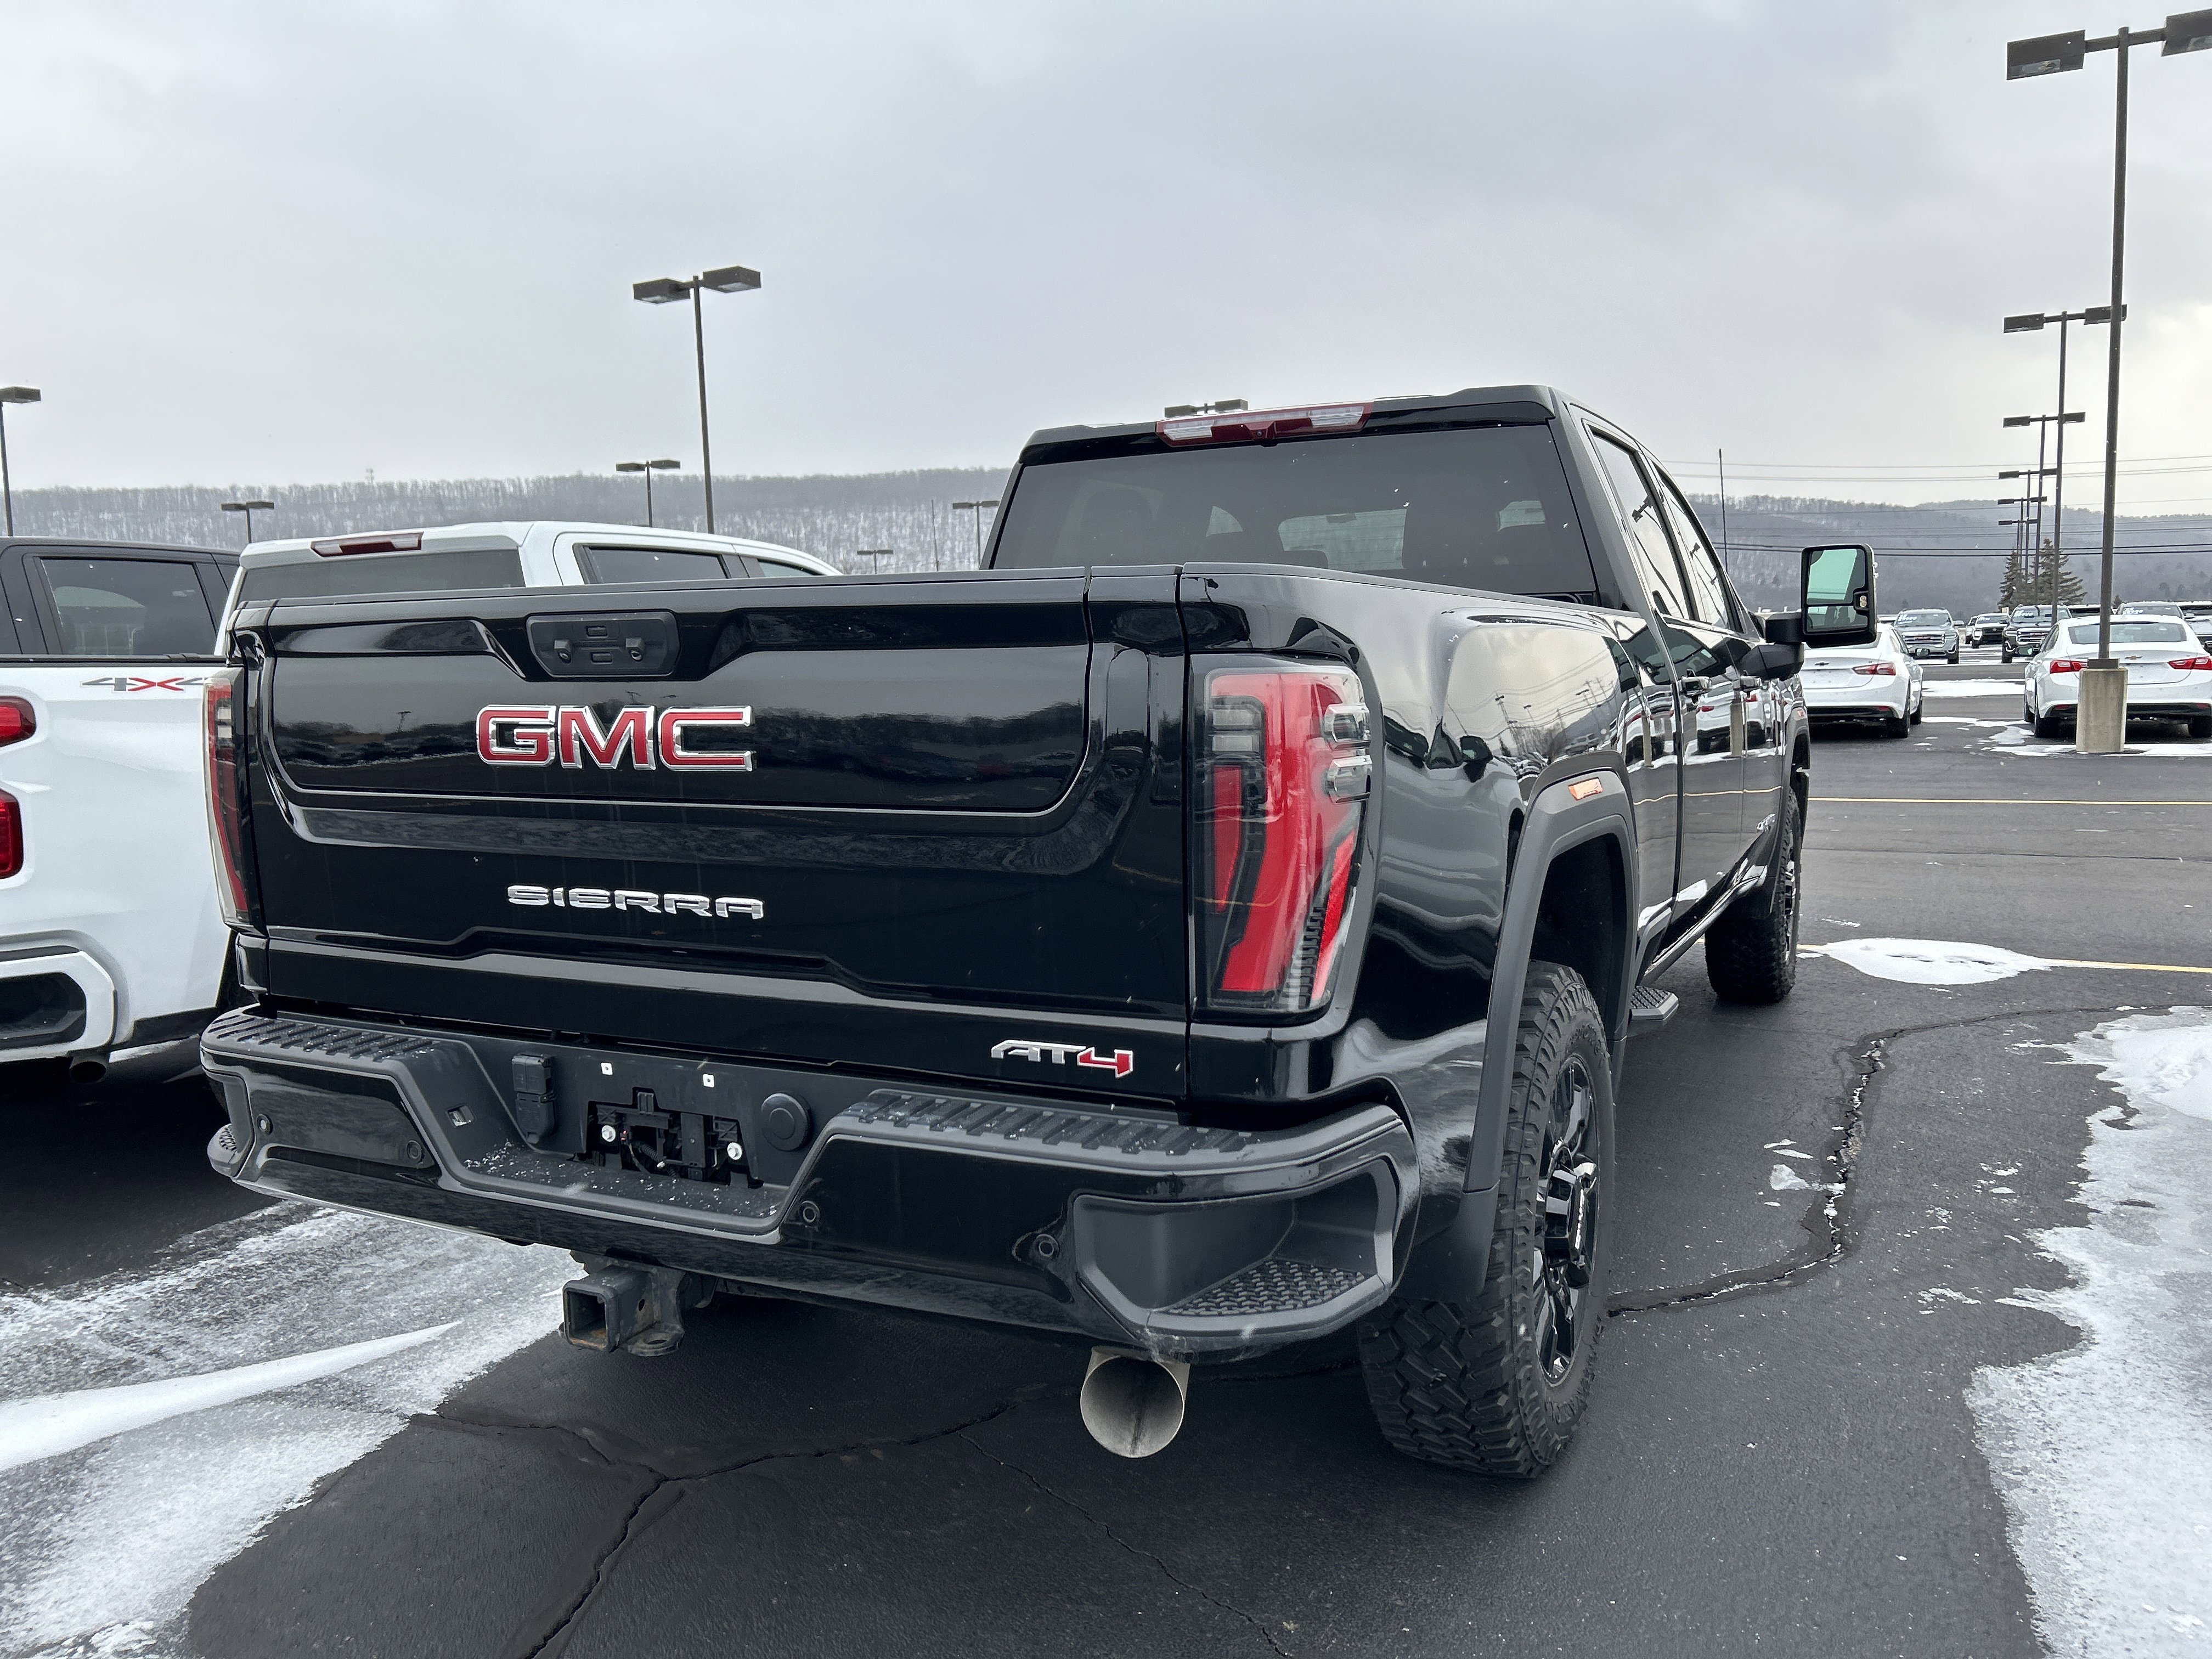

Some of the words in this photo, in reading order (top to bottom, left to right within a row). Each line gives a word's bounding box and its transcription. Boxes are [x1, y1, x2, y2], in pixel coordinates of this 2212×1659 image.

[476, 704, 754, 772] GMC
[507, 884, 765, 920] SIERRA
[991, 1040, 1133, 1079] AT4
